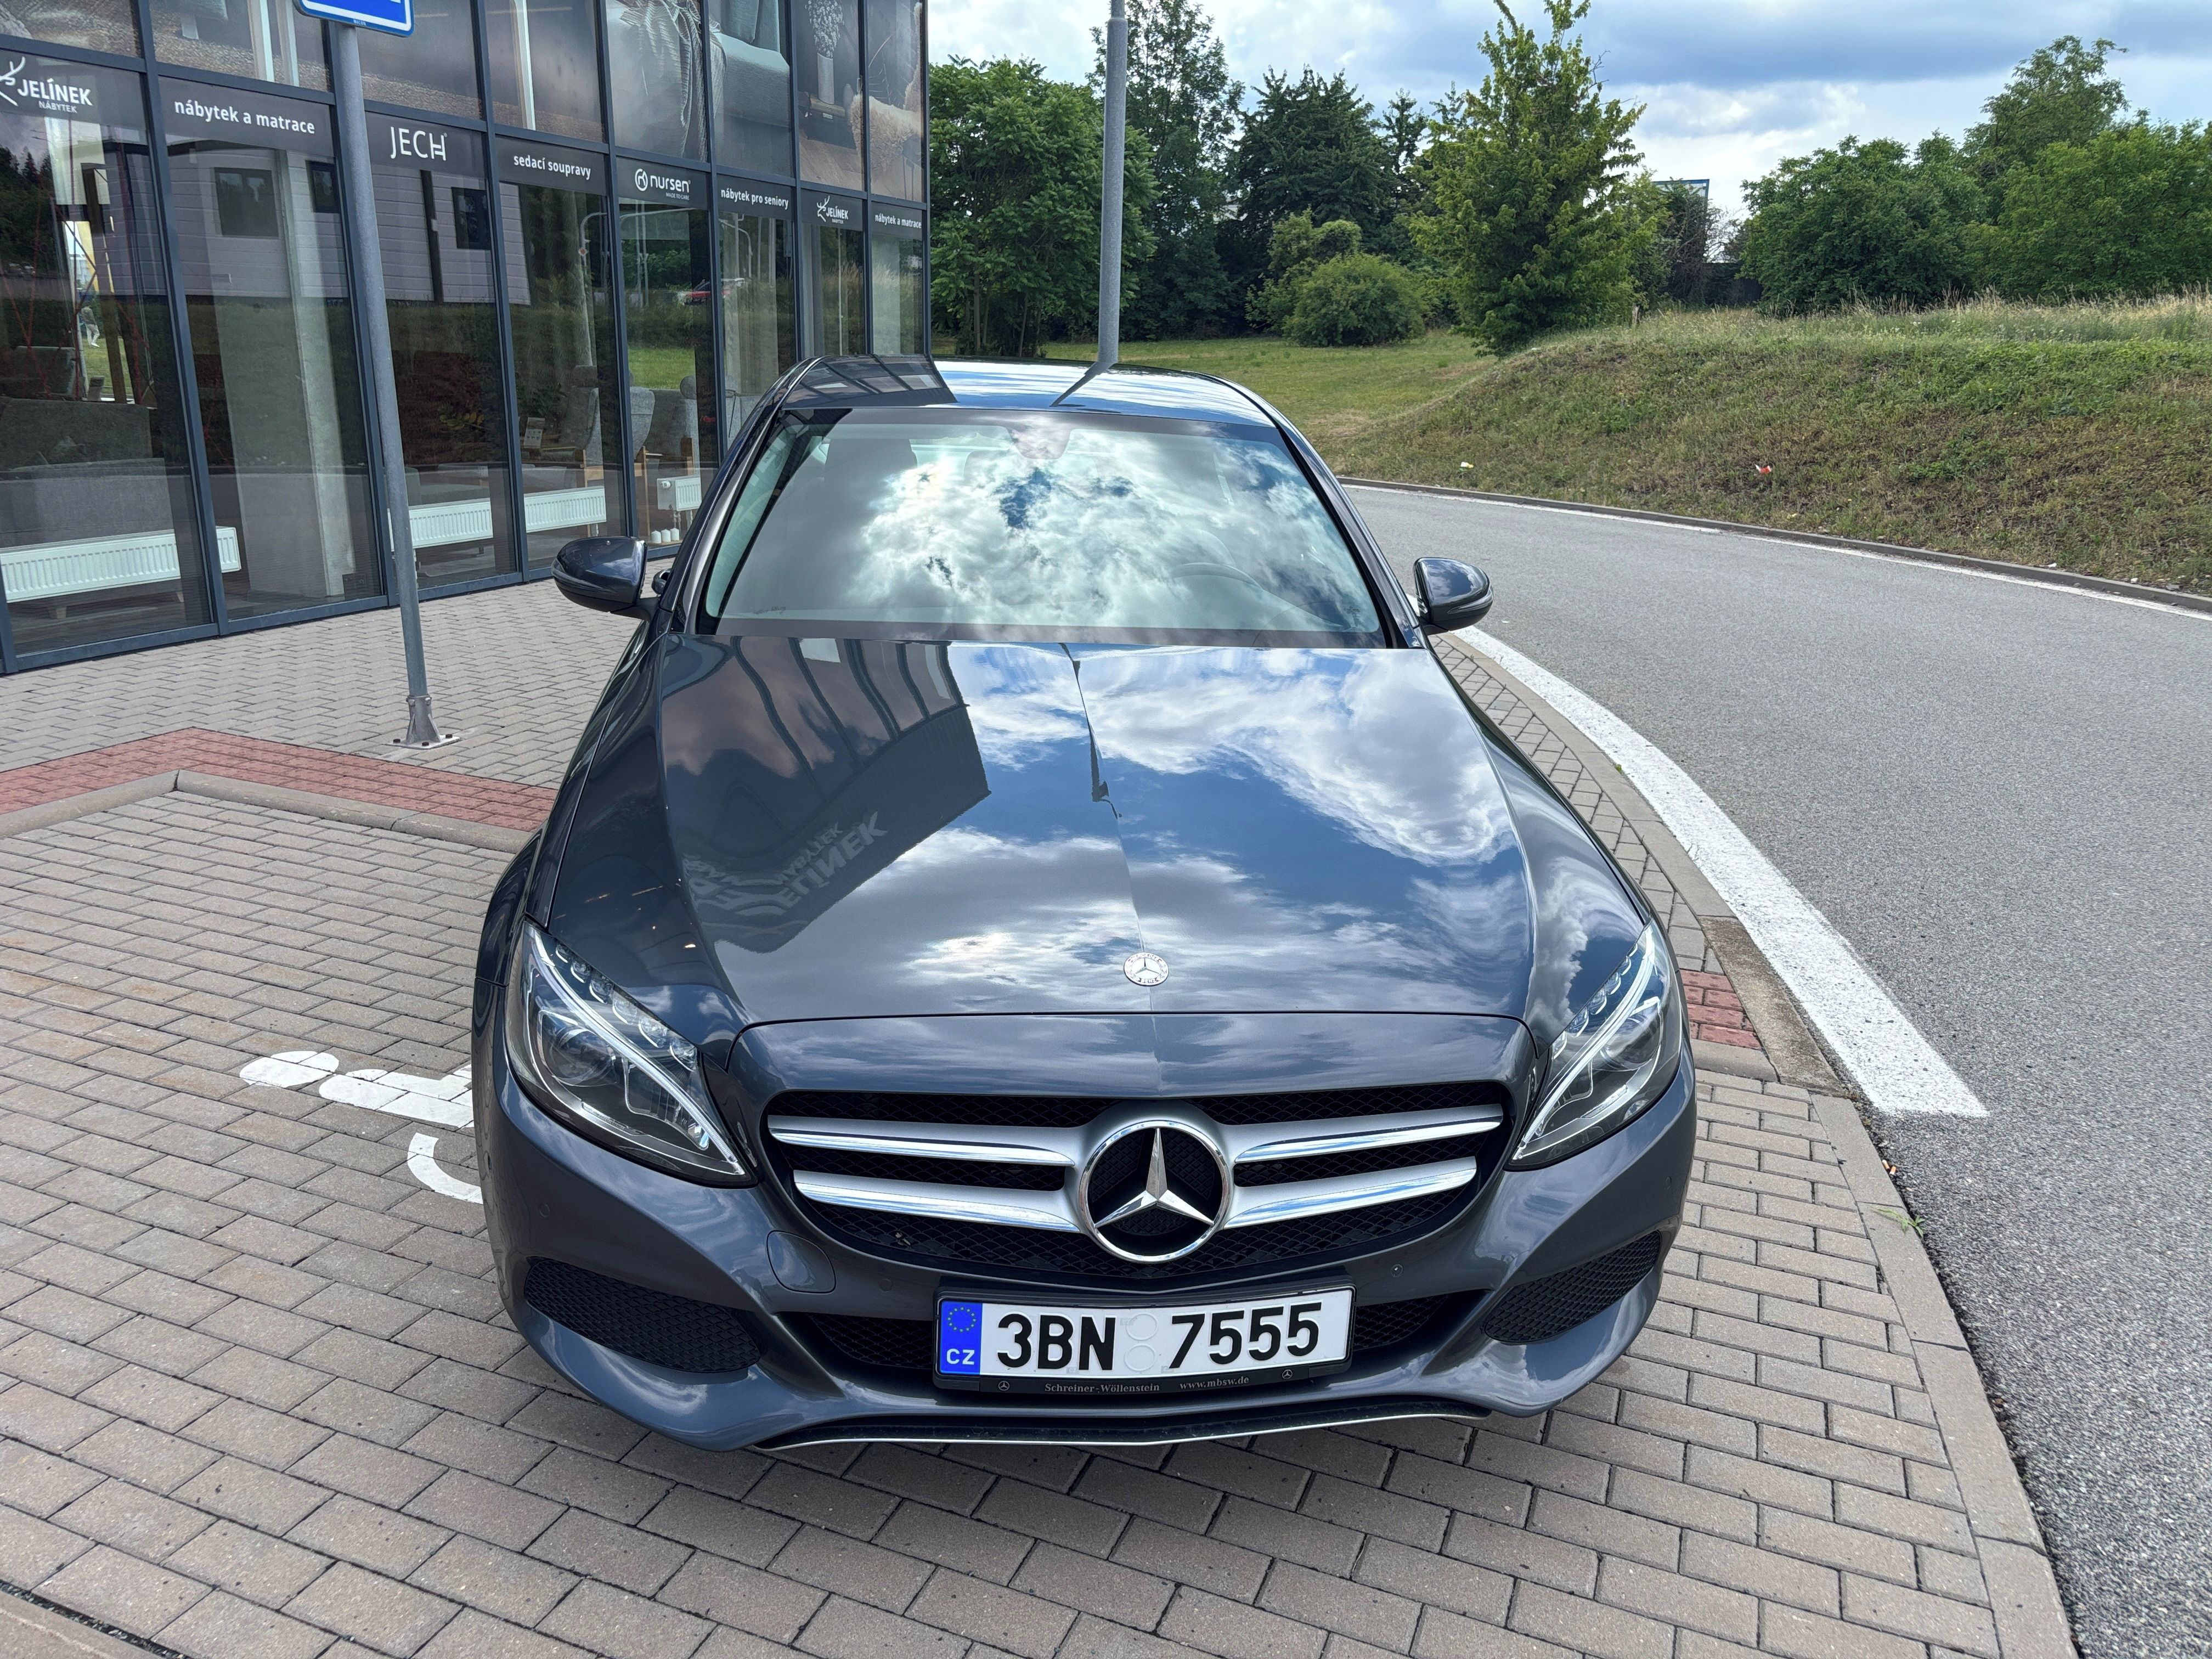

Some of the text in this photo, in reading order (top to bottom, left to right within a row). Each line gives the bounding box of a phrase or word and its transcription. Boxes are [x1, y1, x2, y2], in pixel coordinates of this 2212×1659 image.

[18, 78, 93, 106] JELÍNEK
[38, 101, 78, 113] NÁBYTEK
[174, 99, 315, 134] nábytek a matrace
[514, 155, 591, 180] sedací soupravy
[721, 188, 789, 210] nábytek pro seniory
[826, 206, 849, 219] JELÍNEK
[875, 213, 896, 225] nábytek
[901, 220, 922, 229] matrace
[997, 1302, 1323, 1370] 3BN 7555
[946, 1348, 975, 1365] CZ
[1045, 1375, 1249, 1394] Schreiner-Wöllenstein www.mbsw.de
